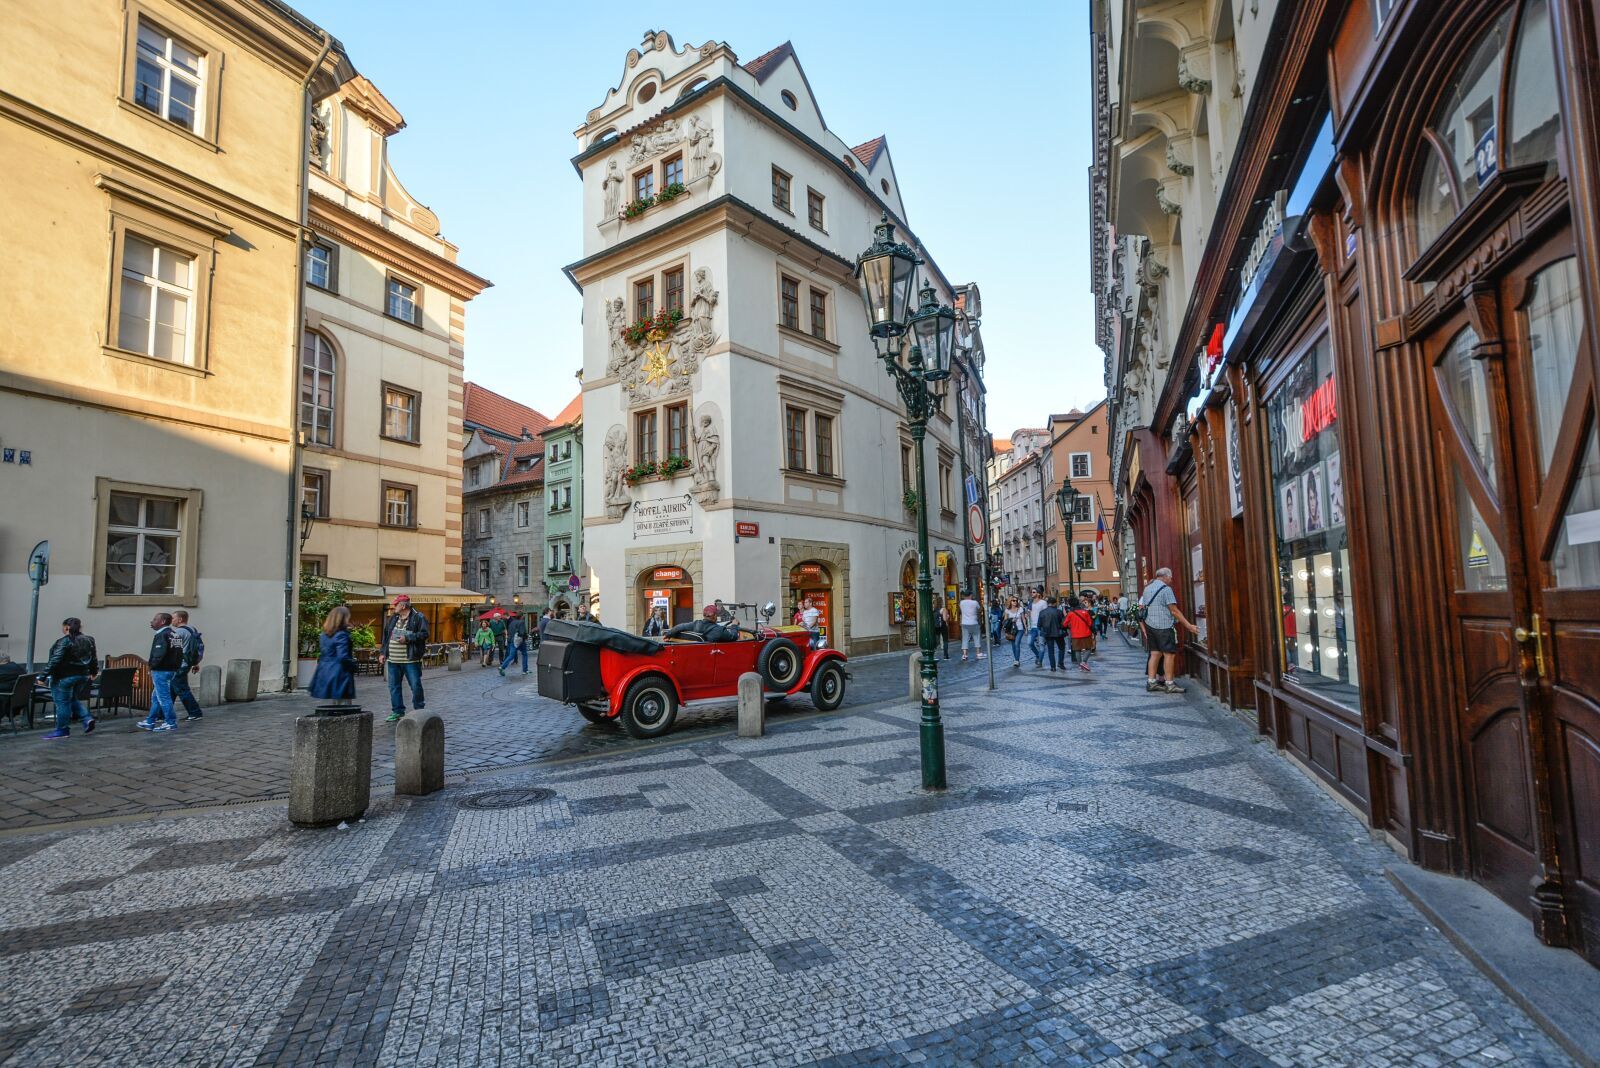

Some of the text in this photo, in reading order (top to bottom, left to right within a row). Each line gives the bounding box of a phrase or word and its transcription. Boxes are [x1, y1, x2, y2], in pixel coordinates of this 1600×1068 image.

[1477, 139, 1496, 176] 22
[638, 502, 687, 517] HOTEL AURUS
[655, 570, 680, 578] change
